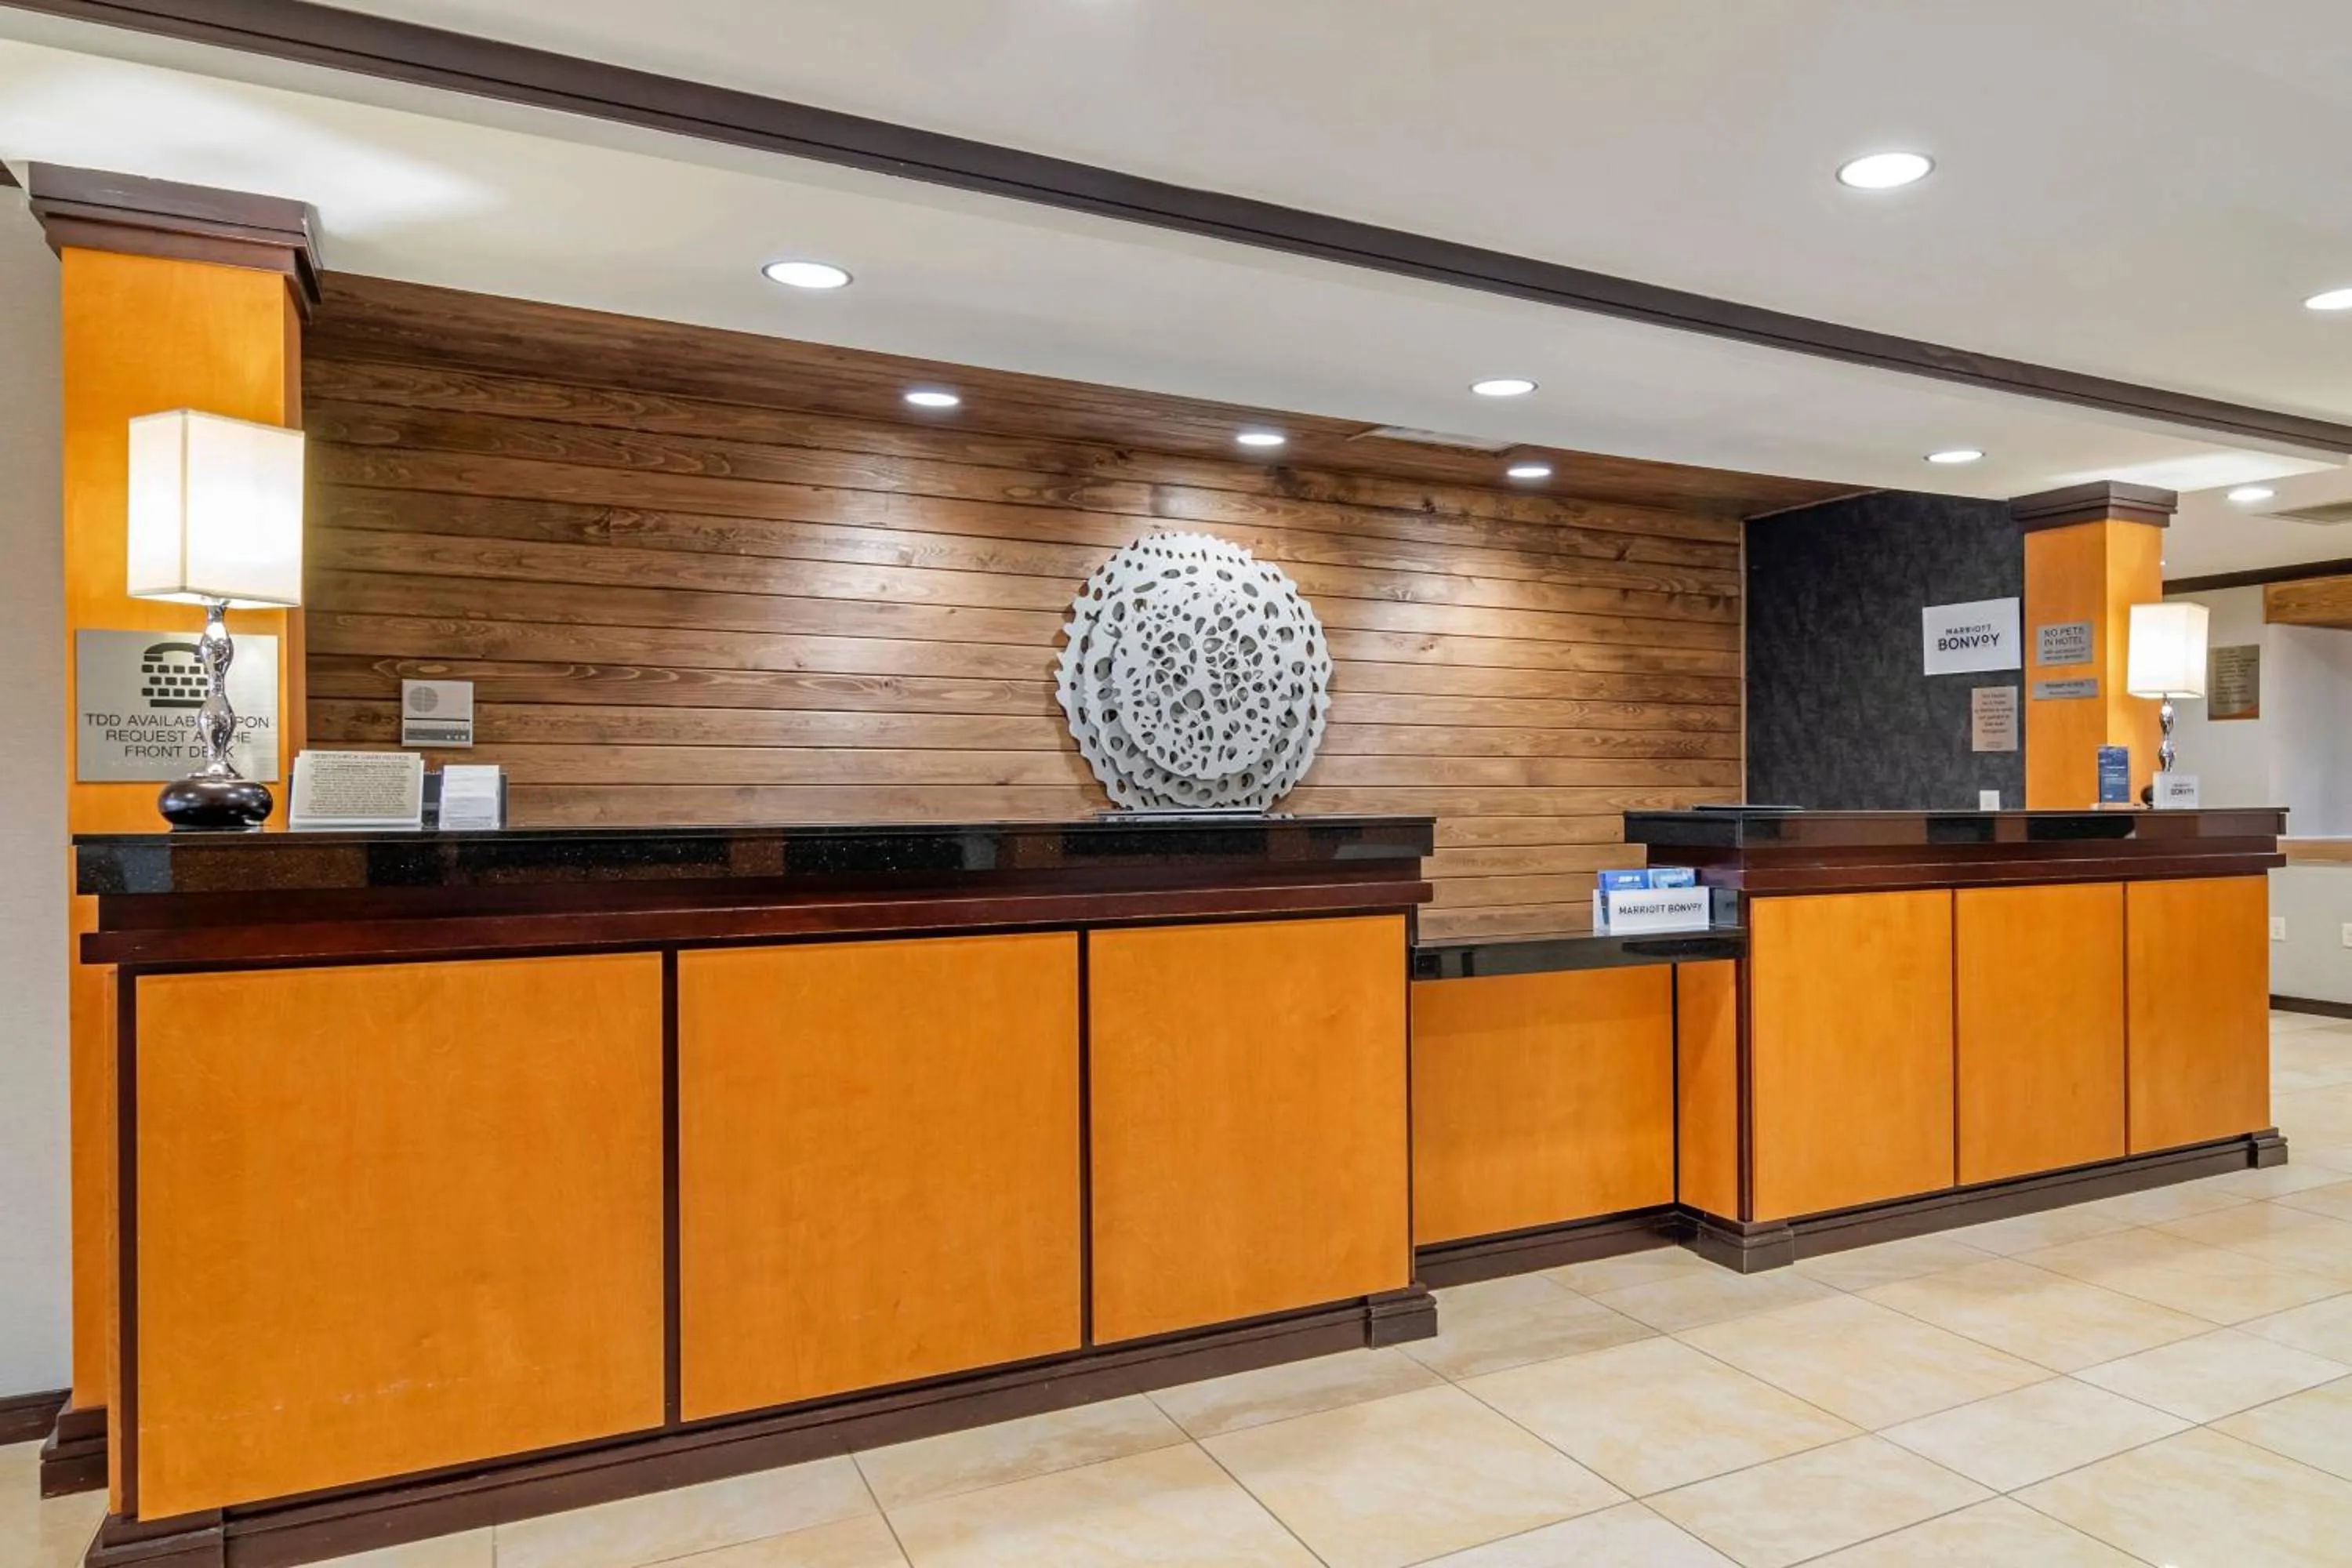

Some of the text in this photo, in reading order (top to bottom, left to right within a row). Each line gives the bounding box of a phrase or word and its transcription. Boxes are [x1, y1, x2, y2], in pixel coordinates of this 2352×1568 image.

[1945, 624, 1991, 635] MARRIOTT
[2044, 629, 2058, 637] NO
[1937, 633, 2000, 651] BONVOY
[2055, 636, 2083, 646] HOTEL
[85, 713, 270, 728] TDD AVAILAB PON
[105, 729, 187, 743] REQUEST
[230, 731, 252, 744] HE
[124, 746, 234, 758] FRONT DEK
[1618, 903, 1703, 915] MARRIOTT BONVOY
